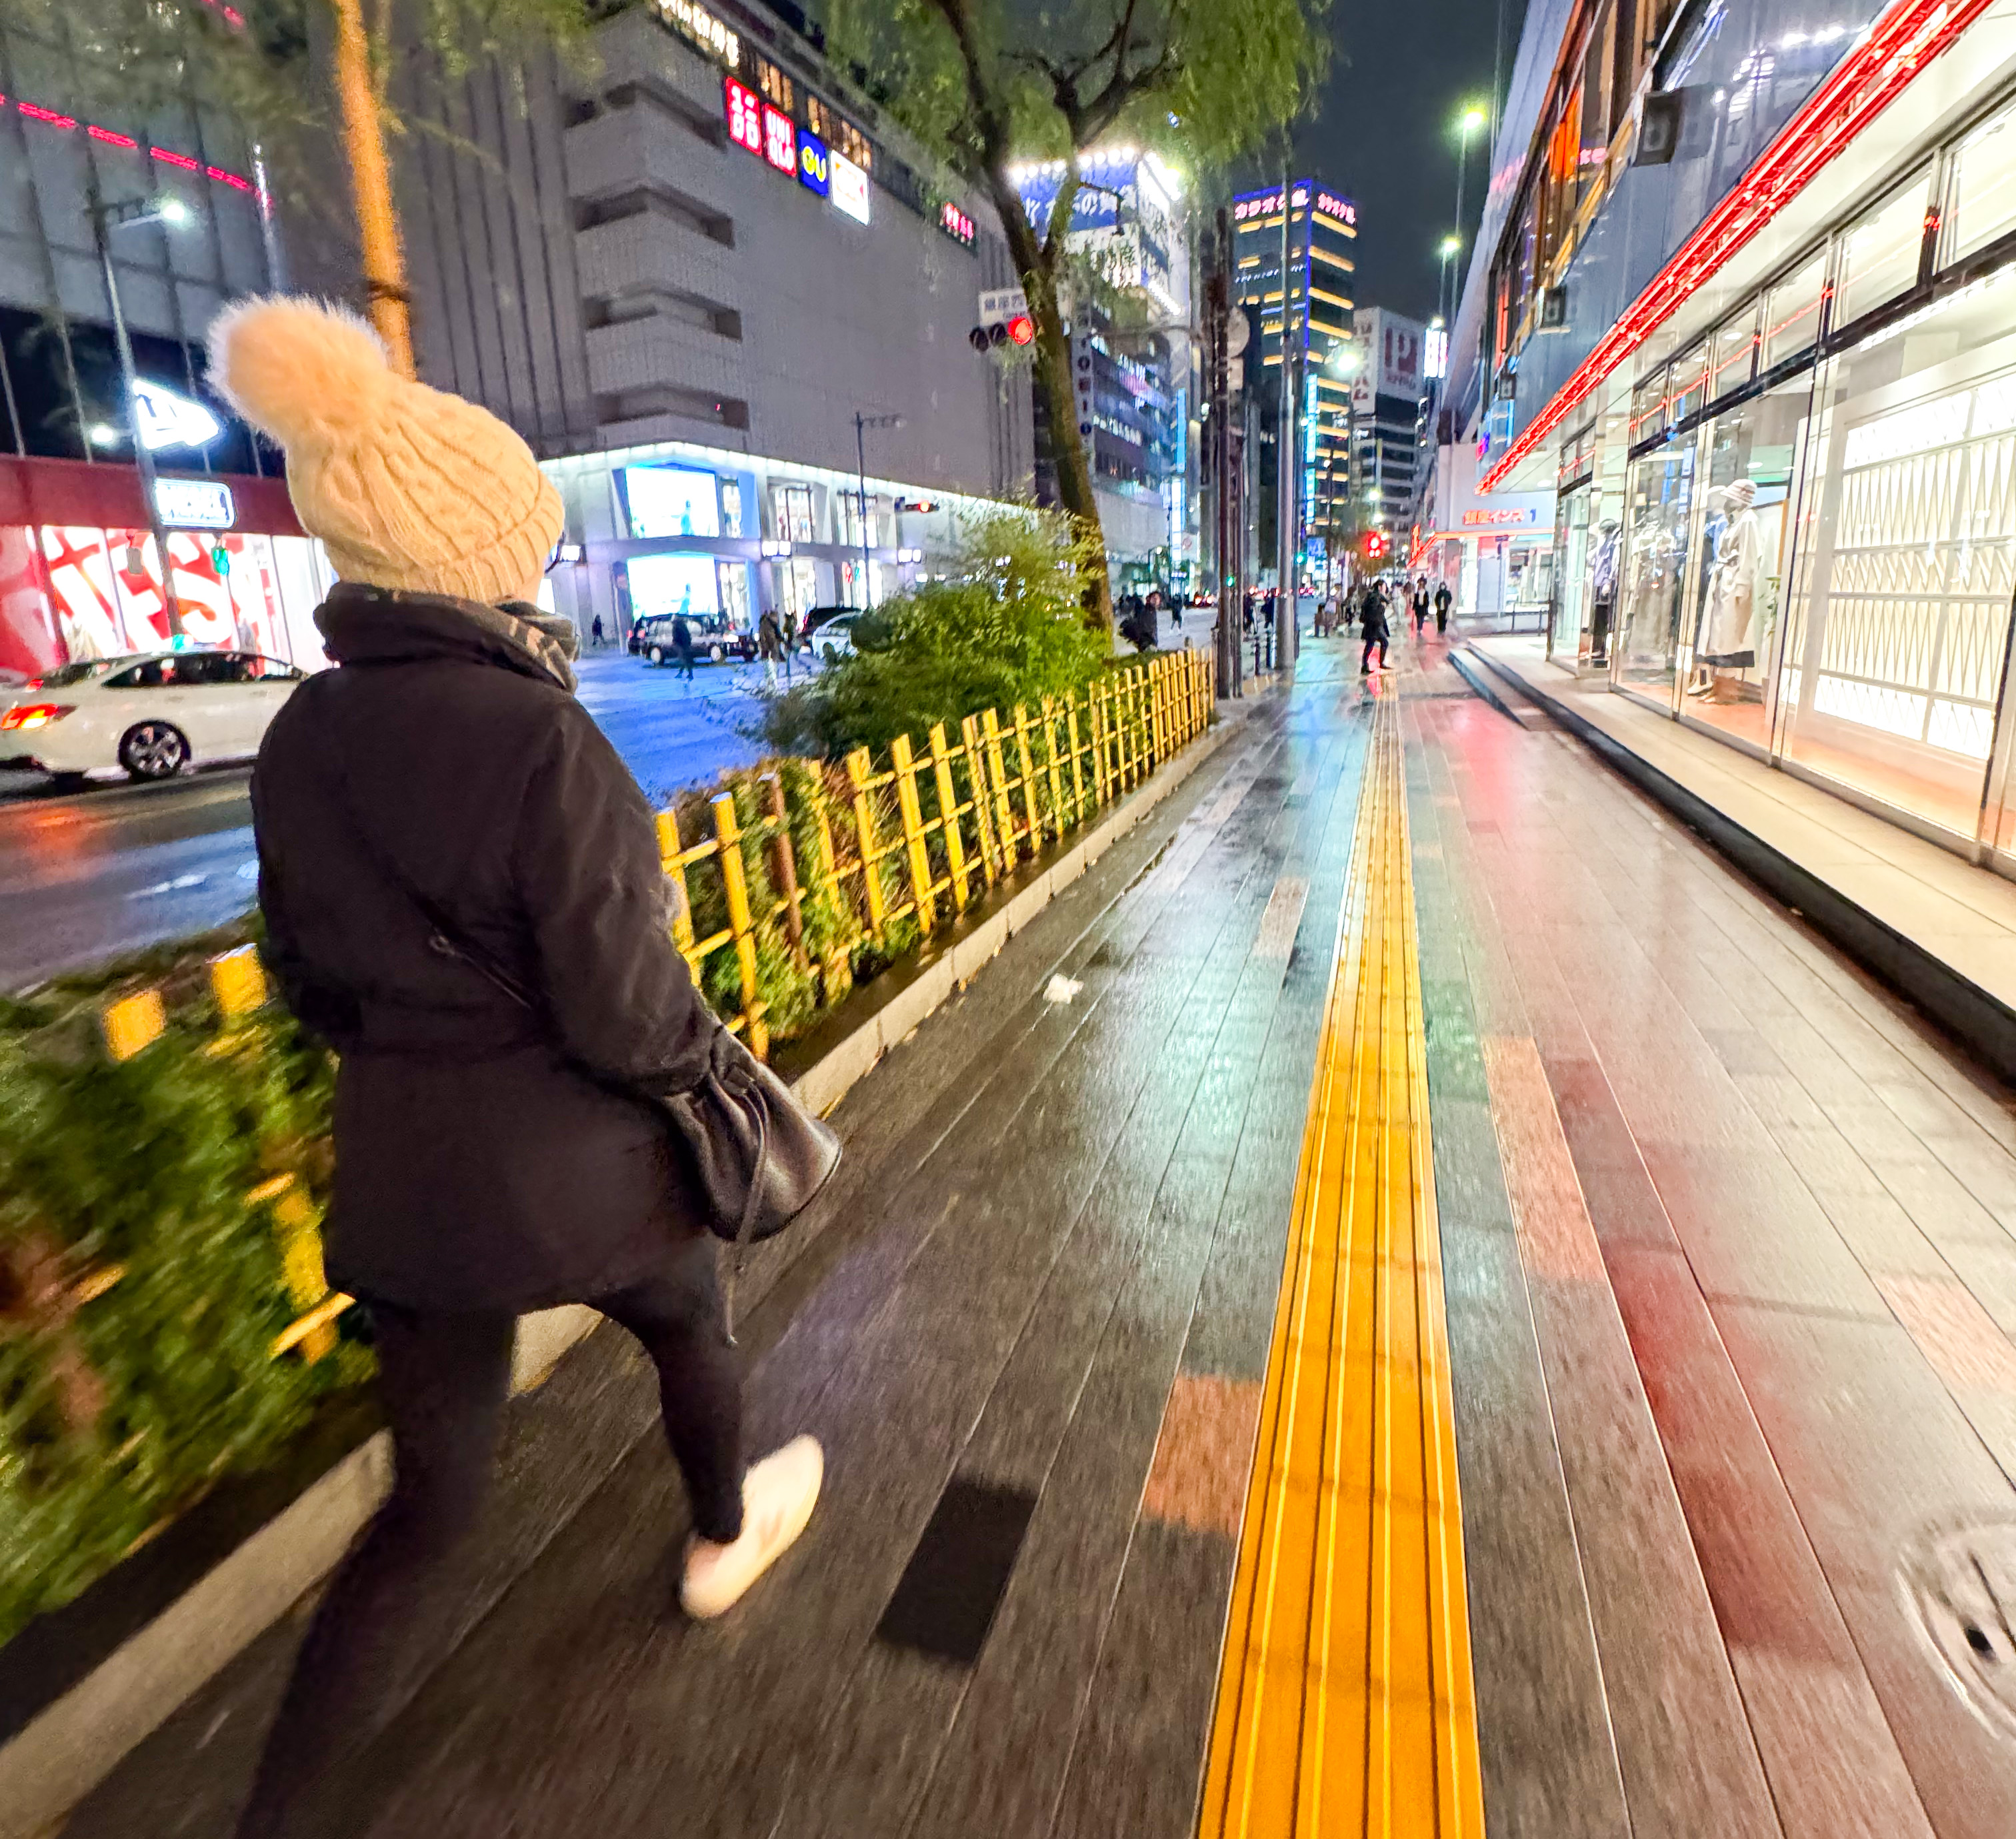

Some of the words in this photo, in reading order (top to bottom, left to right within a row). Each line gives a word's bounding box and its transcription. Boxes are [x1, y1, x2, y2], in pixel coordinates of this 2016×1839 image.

[767, 111, 791, 146] UNI
[769, 137, 794, 170] QLO
[802, 145, 827, 183] GU
